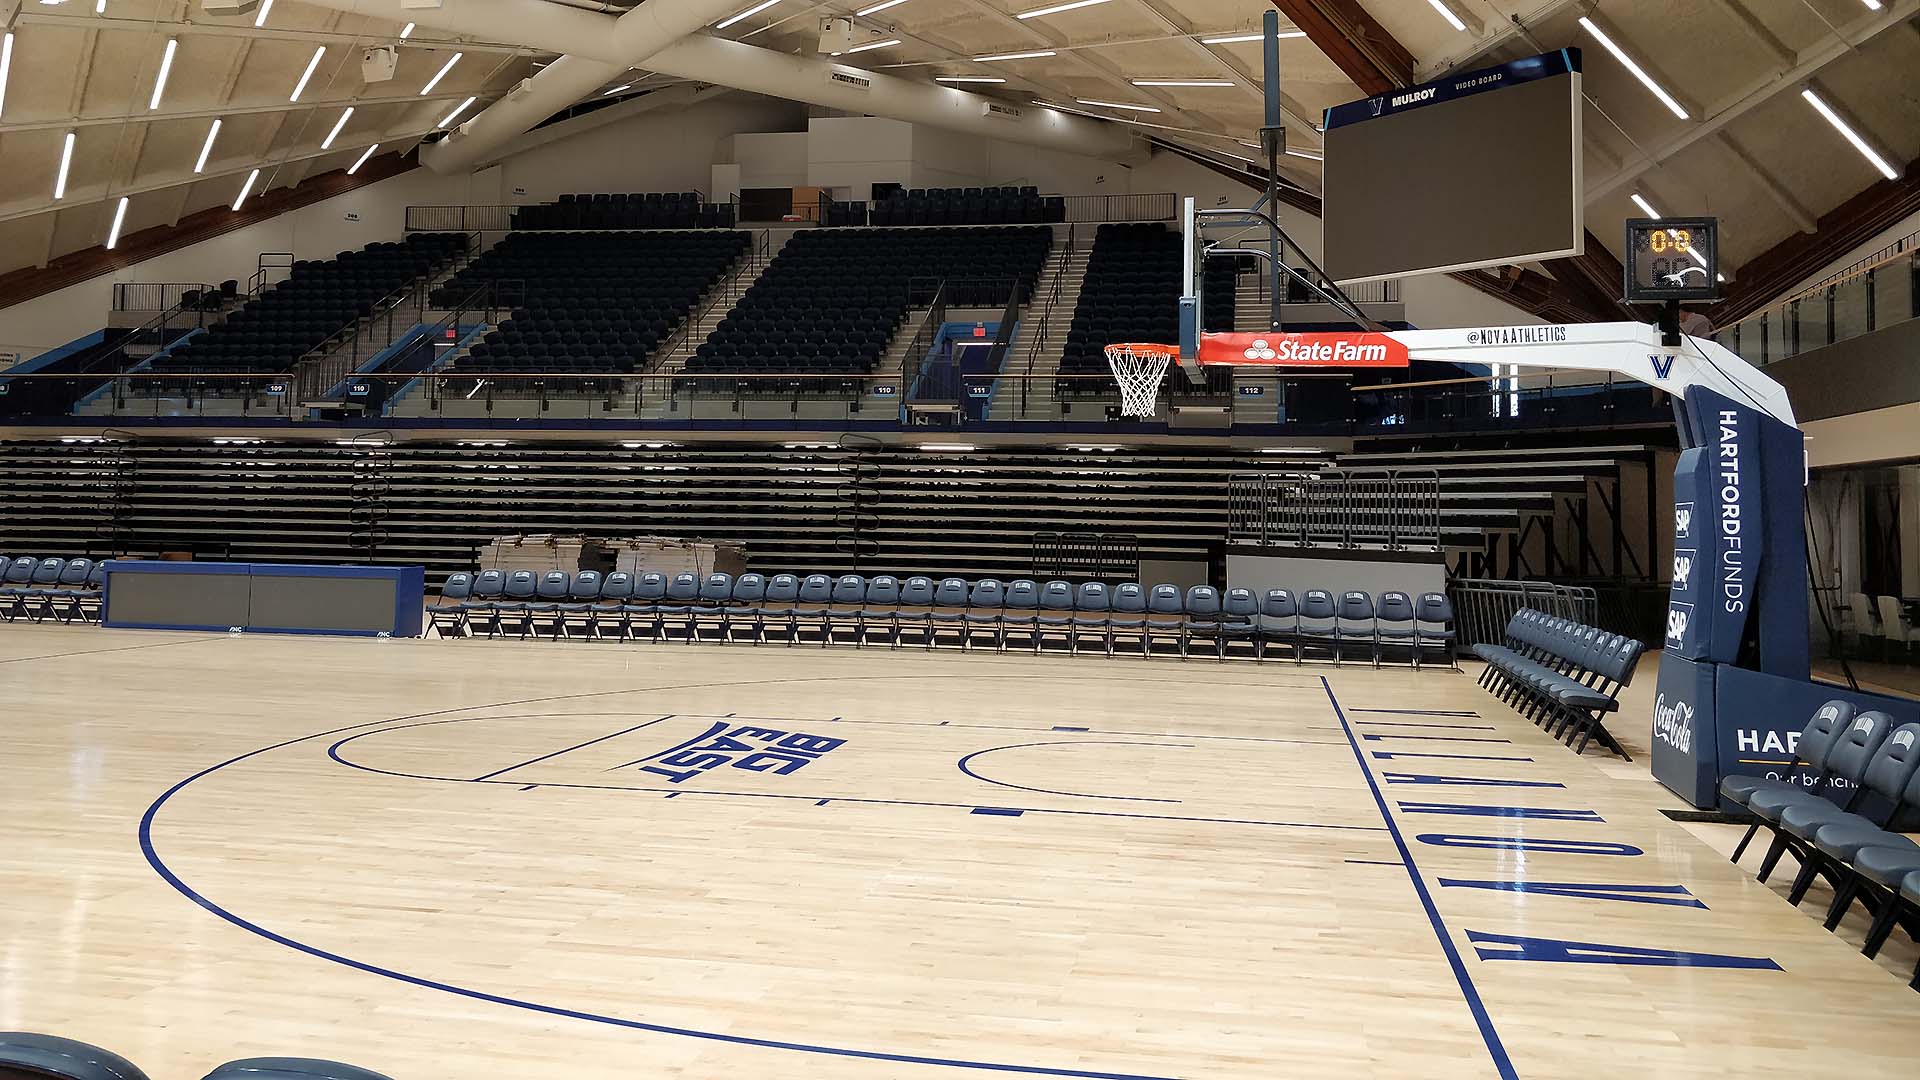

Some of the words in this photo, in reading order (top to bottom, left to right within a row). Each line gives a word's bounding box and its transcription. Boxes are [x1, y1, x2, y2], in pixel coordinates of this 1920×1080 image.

[1455, 79, 1476, 90] VIDEO
[1478, 73, 1502, 85] BOARD
[1392, 88, 1436, 107] MULROY
[1673, 556, 1691, 579] SAP
[1668, 609, 1687, 641] SAP
[638, 725, 789, 784] EAST
[731, 732, 848, 776] BIG
[1765, 771, 1797, 784] Or
